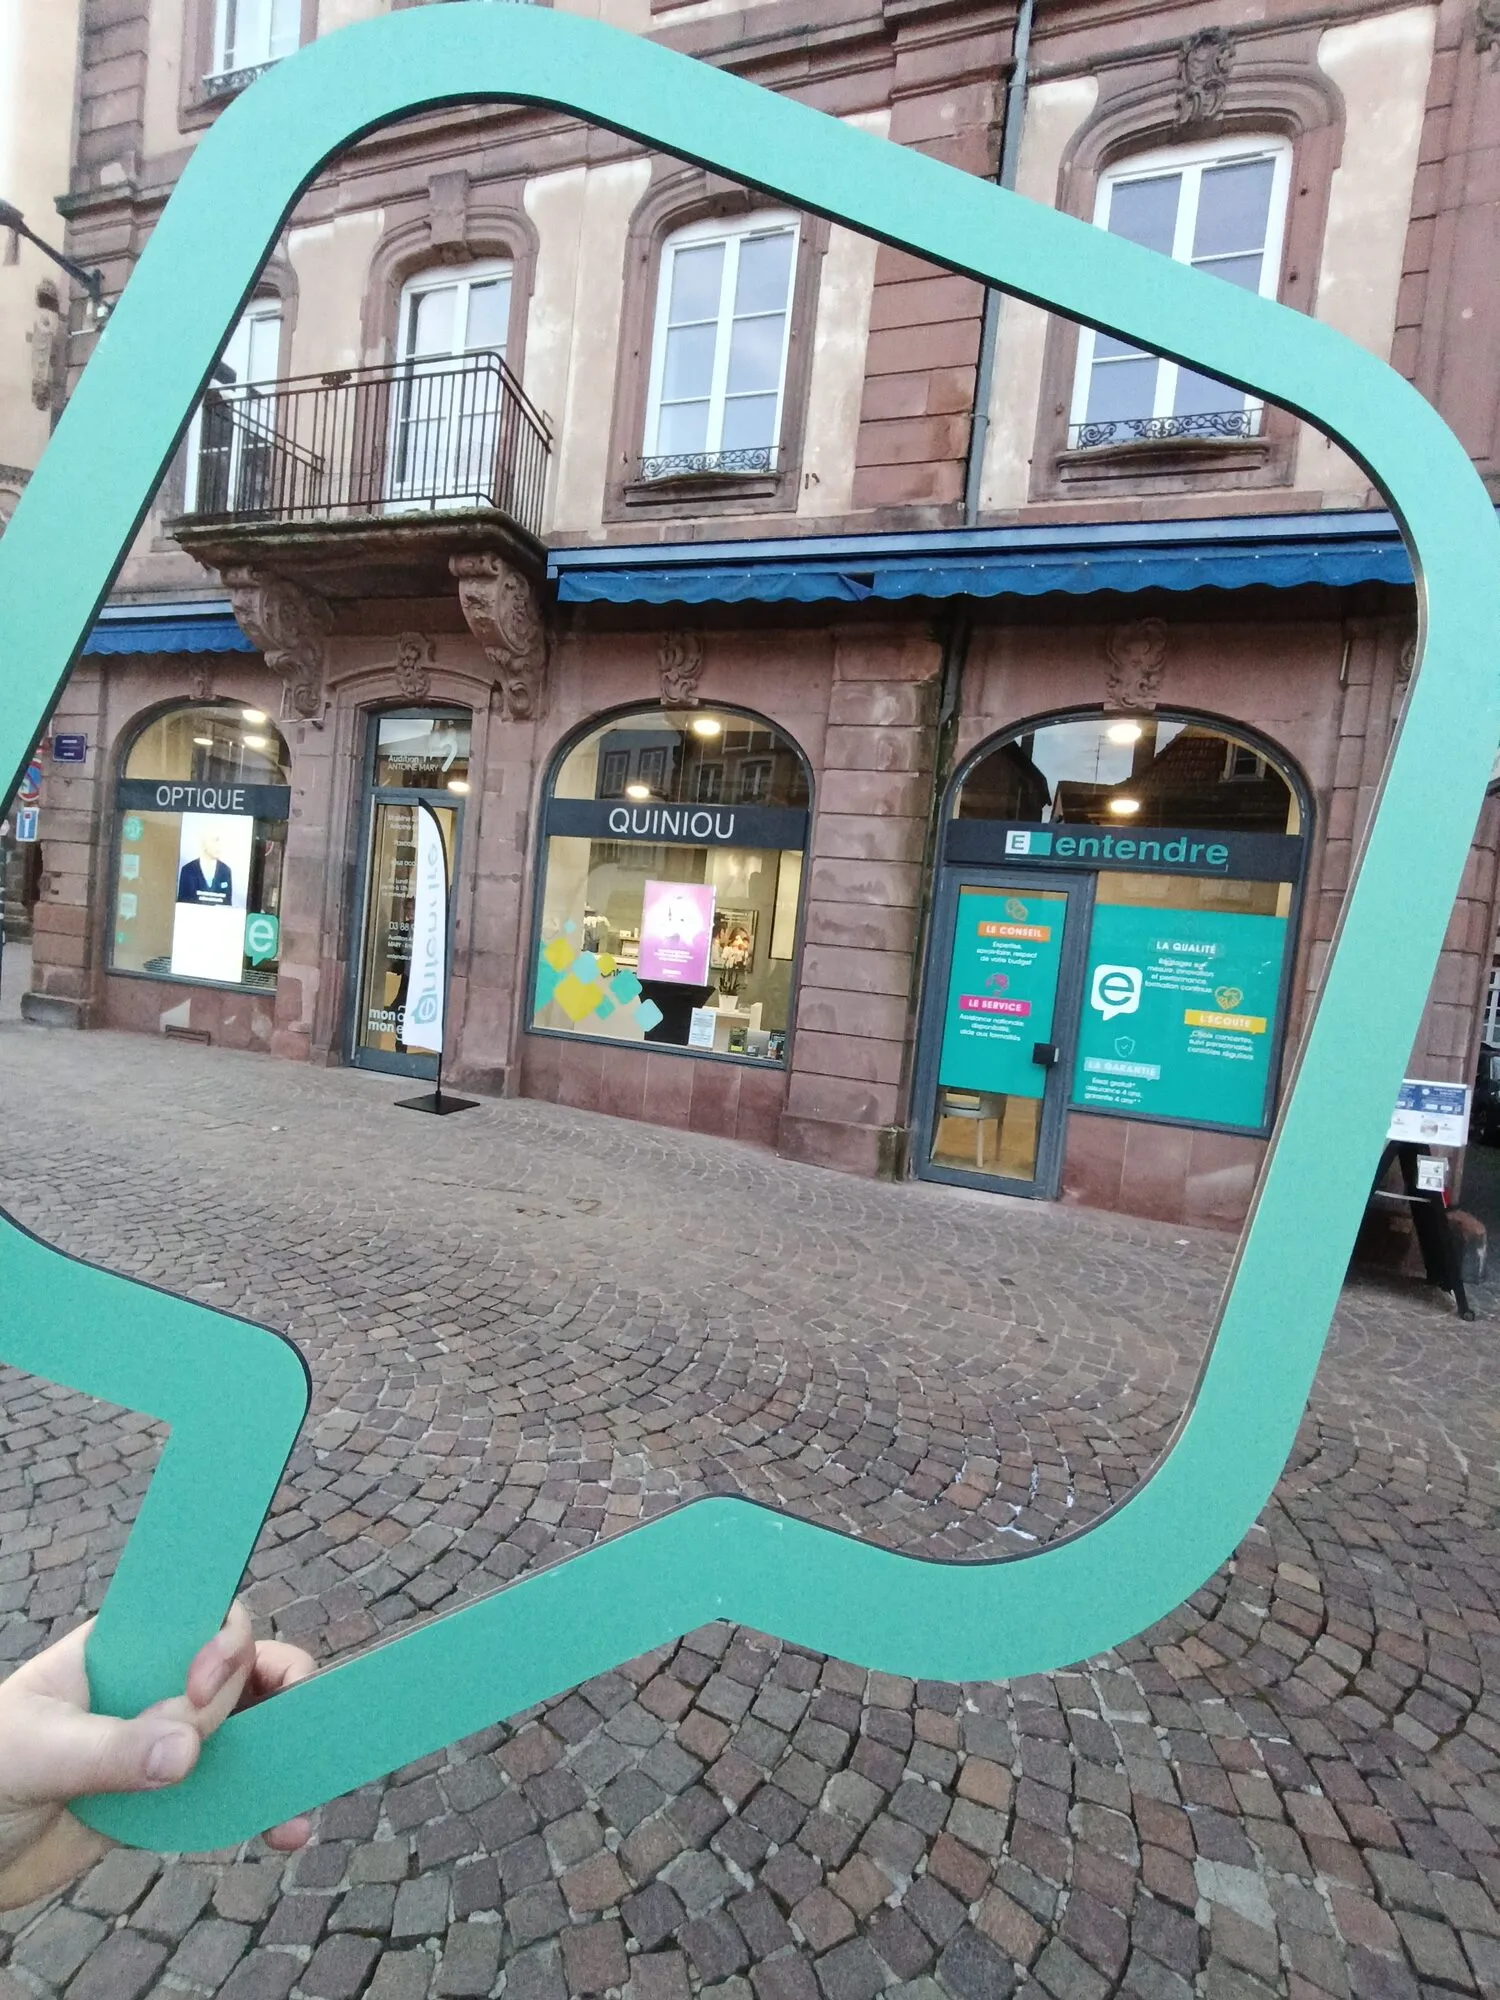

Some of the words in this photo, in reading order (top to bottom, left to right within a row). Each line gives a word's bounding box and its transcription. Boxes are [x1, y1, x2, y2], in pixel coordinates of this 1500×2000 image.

[388, 763, 418, 771] ANTOINE
[419, 764, 439, 772] MARY
[156, 785, 245, 810] OPTIQUE
[609, 807, 735, 839] QUINIOU
[1055, 834, 1229, 865] entendre
[389, 921, 398, 930] 03
[400, 922, 409, 931] 88
[986, 925, 996, 933] LE
[1000, 926, 1042, 937] CONSEIL
[249, 919, 274, 953] e
[1156, 941, 1169, 950] LA
[1173, 942, 1216, 954] QUALITÉ
[1008, 957, 1032, 966] budget
[1013, 951, 1037, 959] respect
[1099, 972, 1134, 1006] e
[1145, 980, 1179, 990] formation
[968, 999, 977, 1007] LE
[982, 1000, 1022, 1012] SERVICE
[369, 1008, 396, 1021] mon
[368, 1020, 394, 1033] mon
[1088, 1061, 1100, 1069] LA
[1104, 1062, 1156, 1076] GARANTIE
